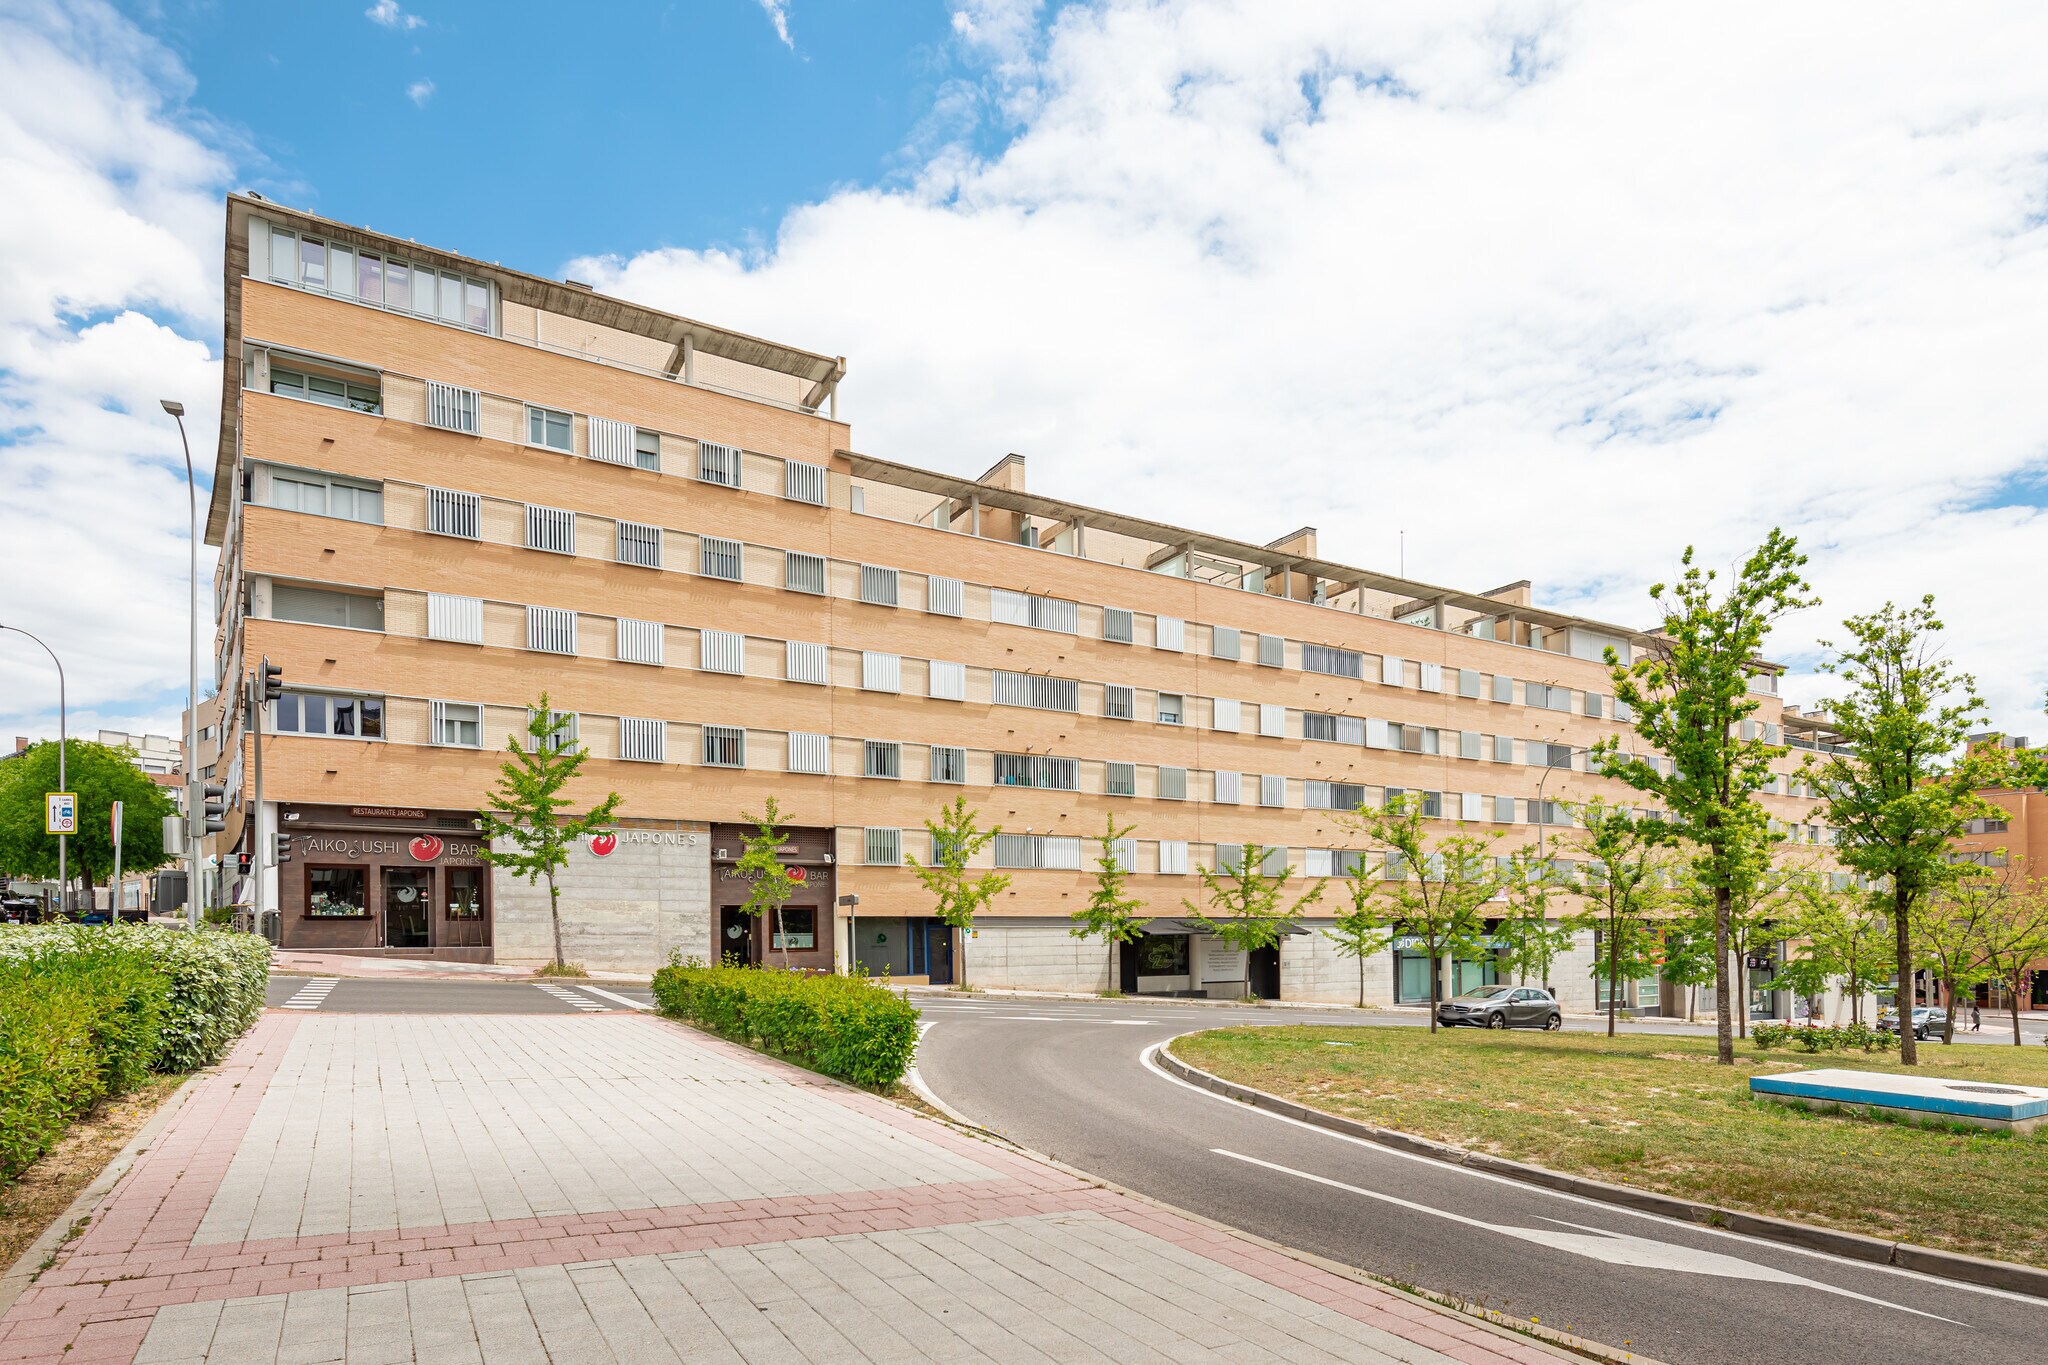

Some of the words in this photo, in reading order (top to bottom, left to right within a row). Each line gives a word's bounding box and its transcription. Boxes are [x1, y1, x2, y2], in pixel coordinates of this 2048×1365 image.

[353, 807, 396, 816] RESTAURANTE
[622, 831, 697, 846] JAPONES
[292, 835, 347, 856] TAIKO
[348, 840, 399, 859] SUSHI
[450, 843, 480, 856] BAR
[810, 871, 829, 881] BAR
